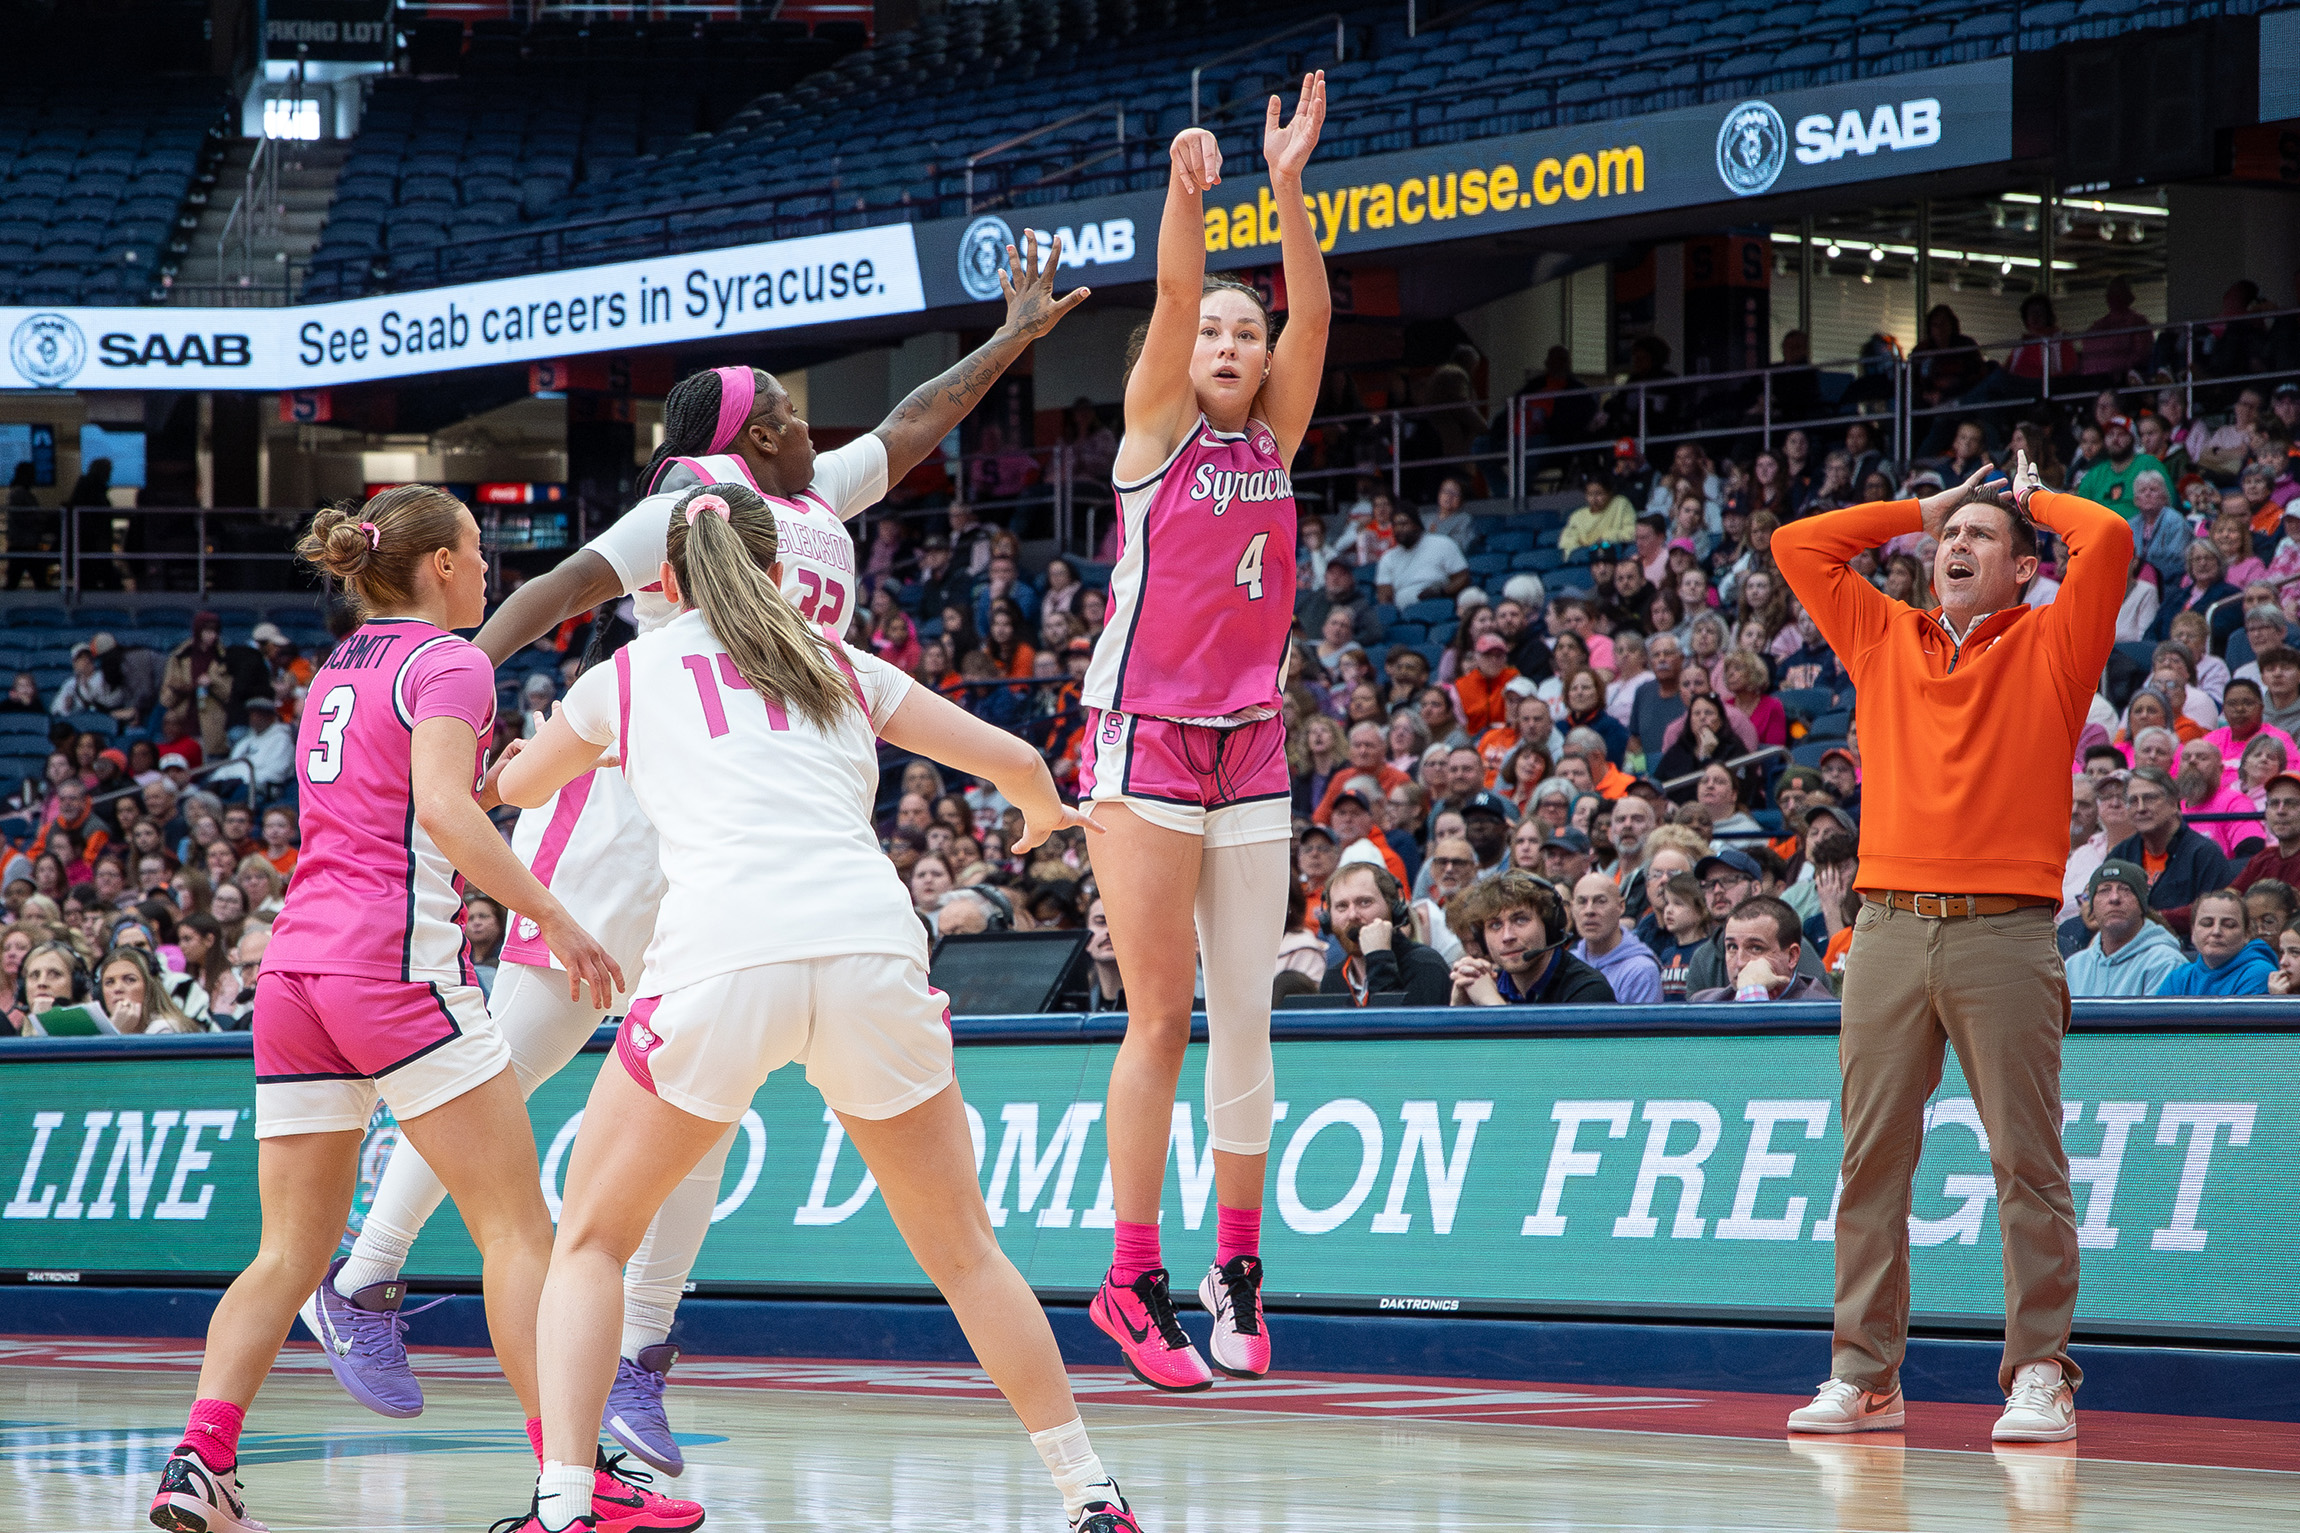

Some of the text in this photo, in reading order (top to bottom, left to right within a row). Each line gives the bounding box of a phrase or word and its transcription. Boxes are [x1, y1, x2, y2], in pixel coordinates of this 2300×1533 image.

[1795, 97, 1942, 165] SAAB
[1205, 144, 1645, 253] aabyracuse.com
[1020, 217, 1136, 274] SAAB
[300, 258, 885, 366] See Saab careers in Syracuse.
[99, 333, 251, 367] SAAB
[1235, 531, 1270, 601] 4
[307, 684, 357, 784] 3
[1102, 711, 1125, 745] S
[2, 1110, 239, 1220] LINE
[1520, 1098, 2258, 1252] FREGHT
[1379, 1298, 1460, 1311] DAKTRONICS
